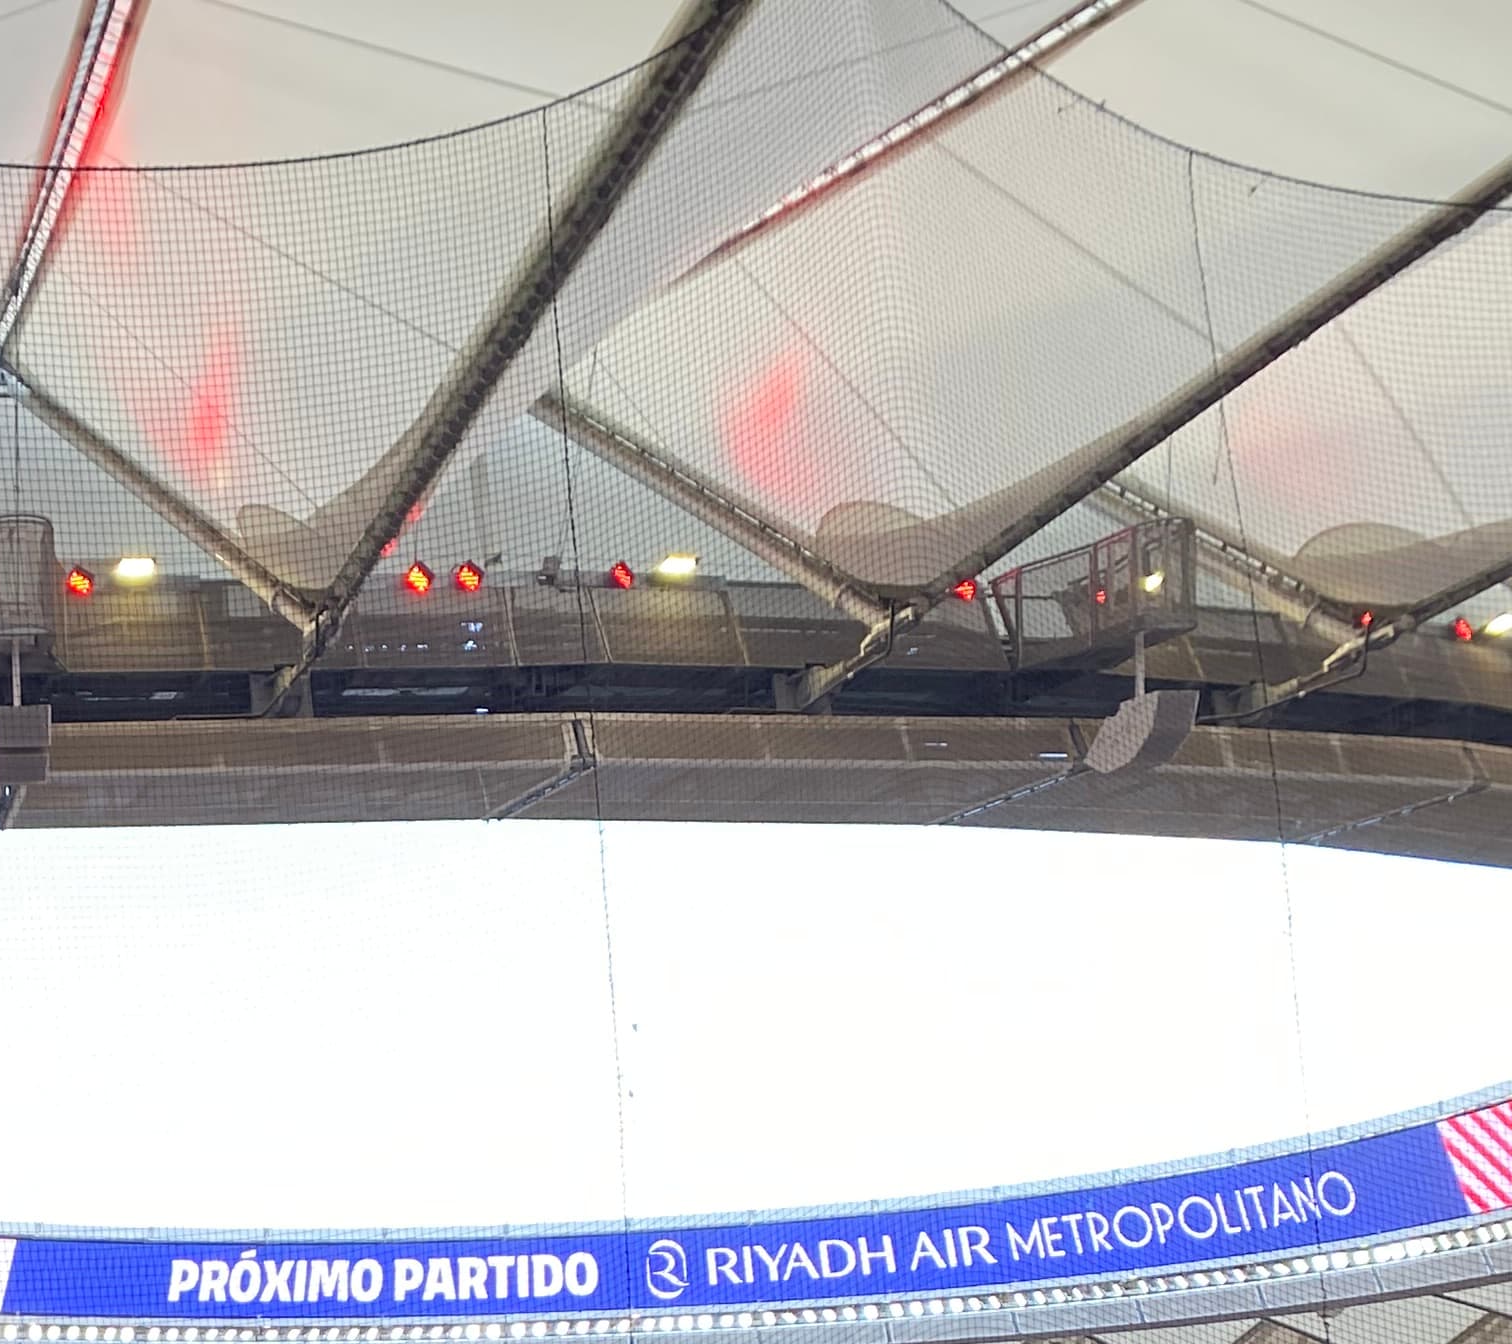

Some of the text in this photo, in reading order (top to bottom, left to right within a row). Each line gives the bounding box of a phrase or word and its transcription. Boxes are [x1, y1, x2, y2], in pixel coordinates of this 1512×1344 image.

[706, 1171, 1356, 1286] RIYADH AIR METROPOLITANO
[167, 1249, 599, 1303] PRÓXIMO PARTIDO
